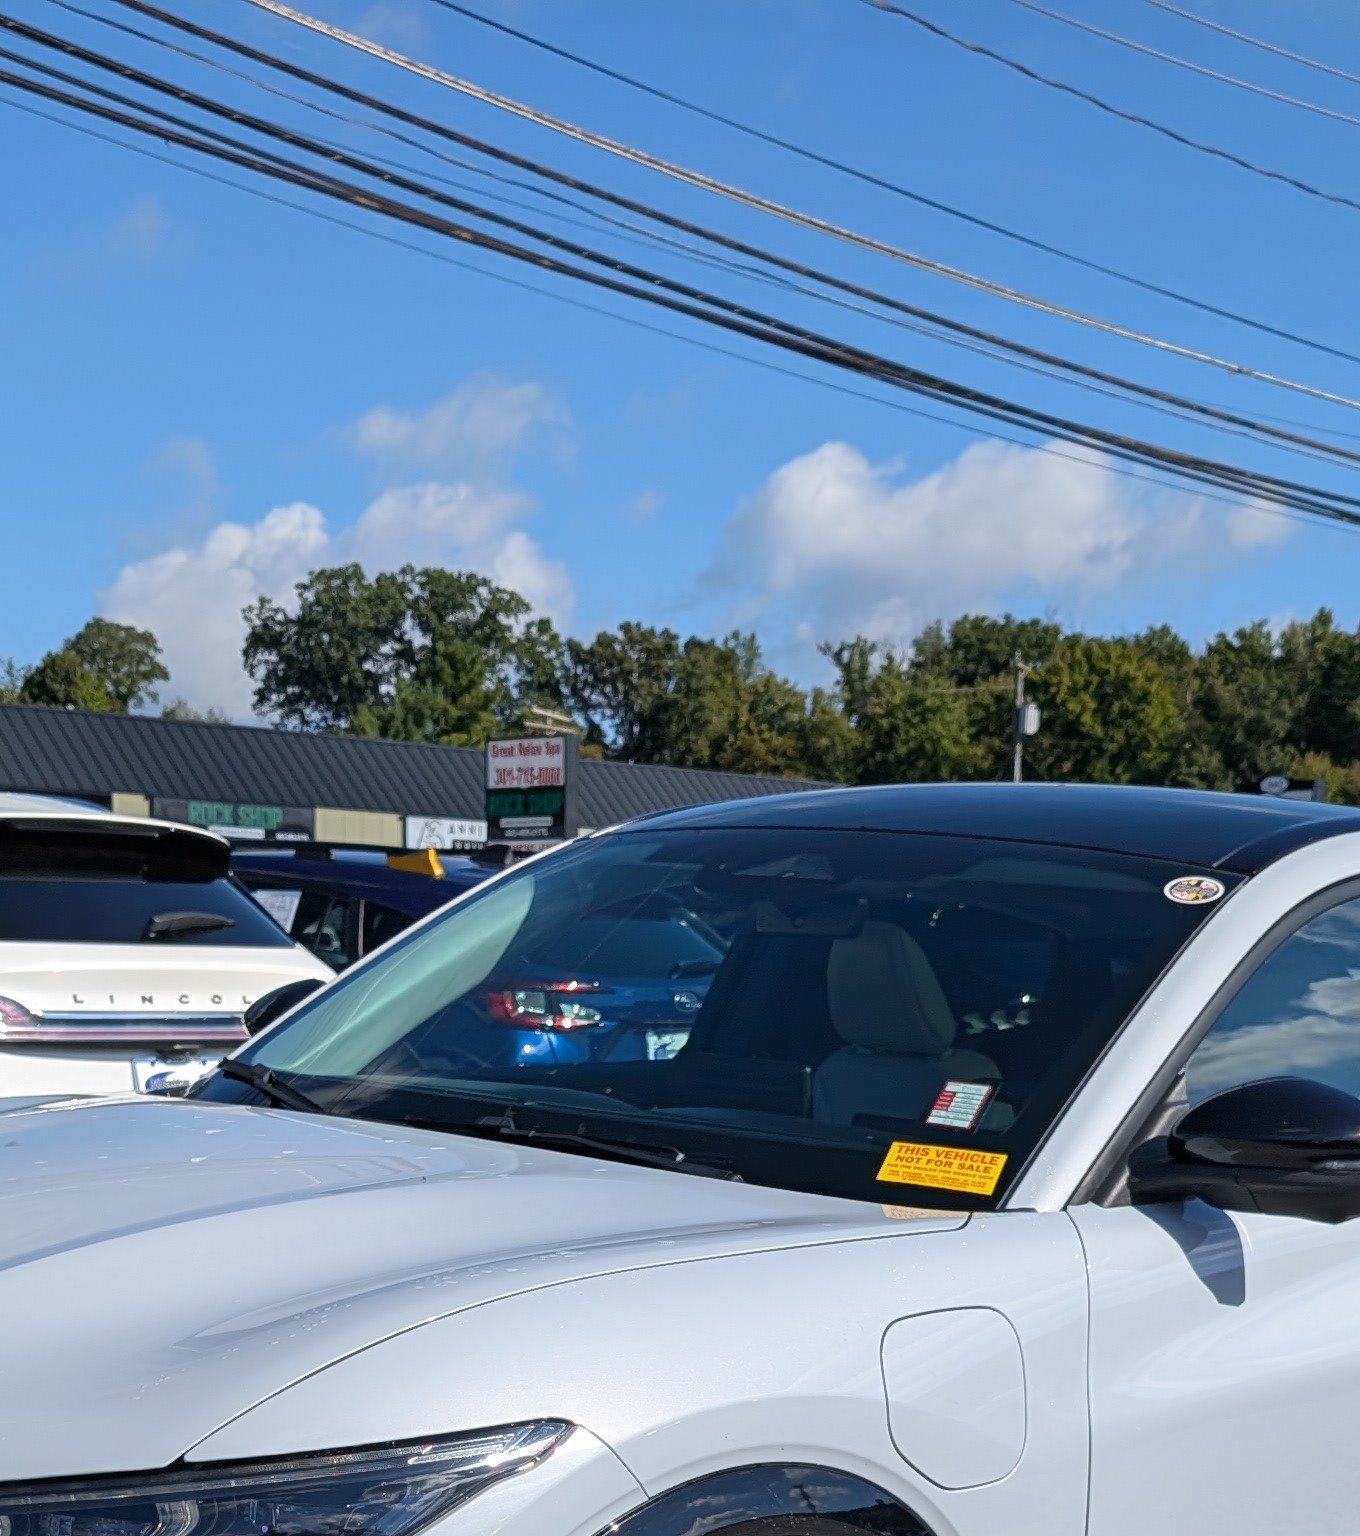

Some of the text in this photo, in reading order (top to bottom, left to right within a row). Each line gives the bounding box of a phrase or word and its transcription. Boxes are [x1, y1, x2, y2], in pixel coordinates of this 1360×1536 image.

[187, 800, 283, 830] ROCK SHOP
[72, 994, 253, 1005] LINCOL
[895, 1155, 992, 1174] NOT FOR SALE
[896, 1144, 1001, 1166] THIS VEHICLE
